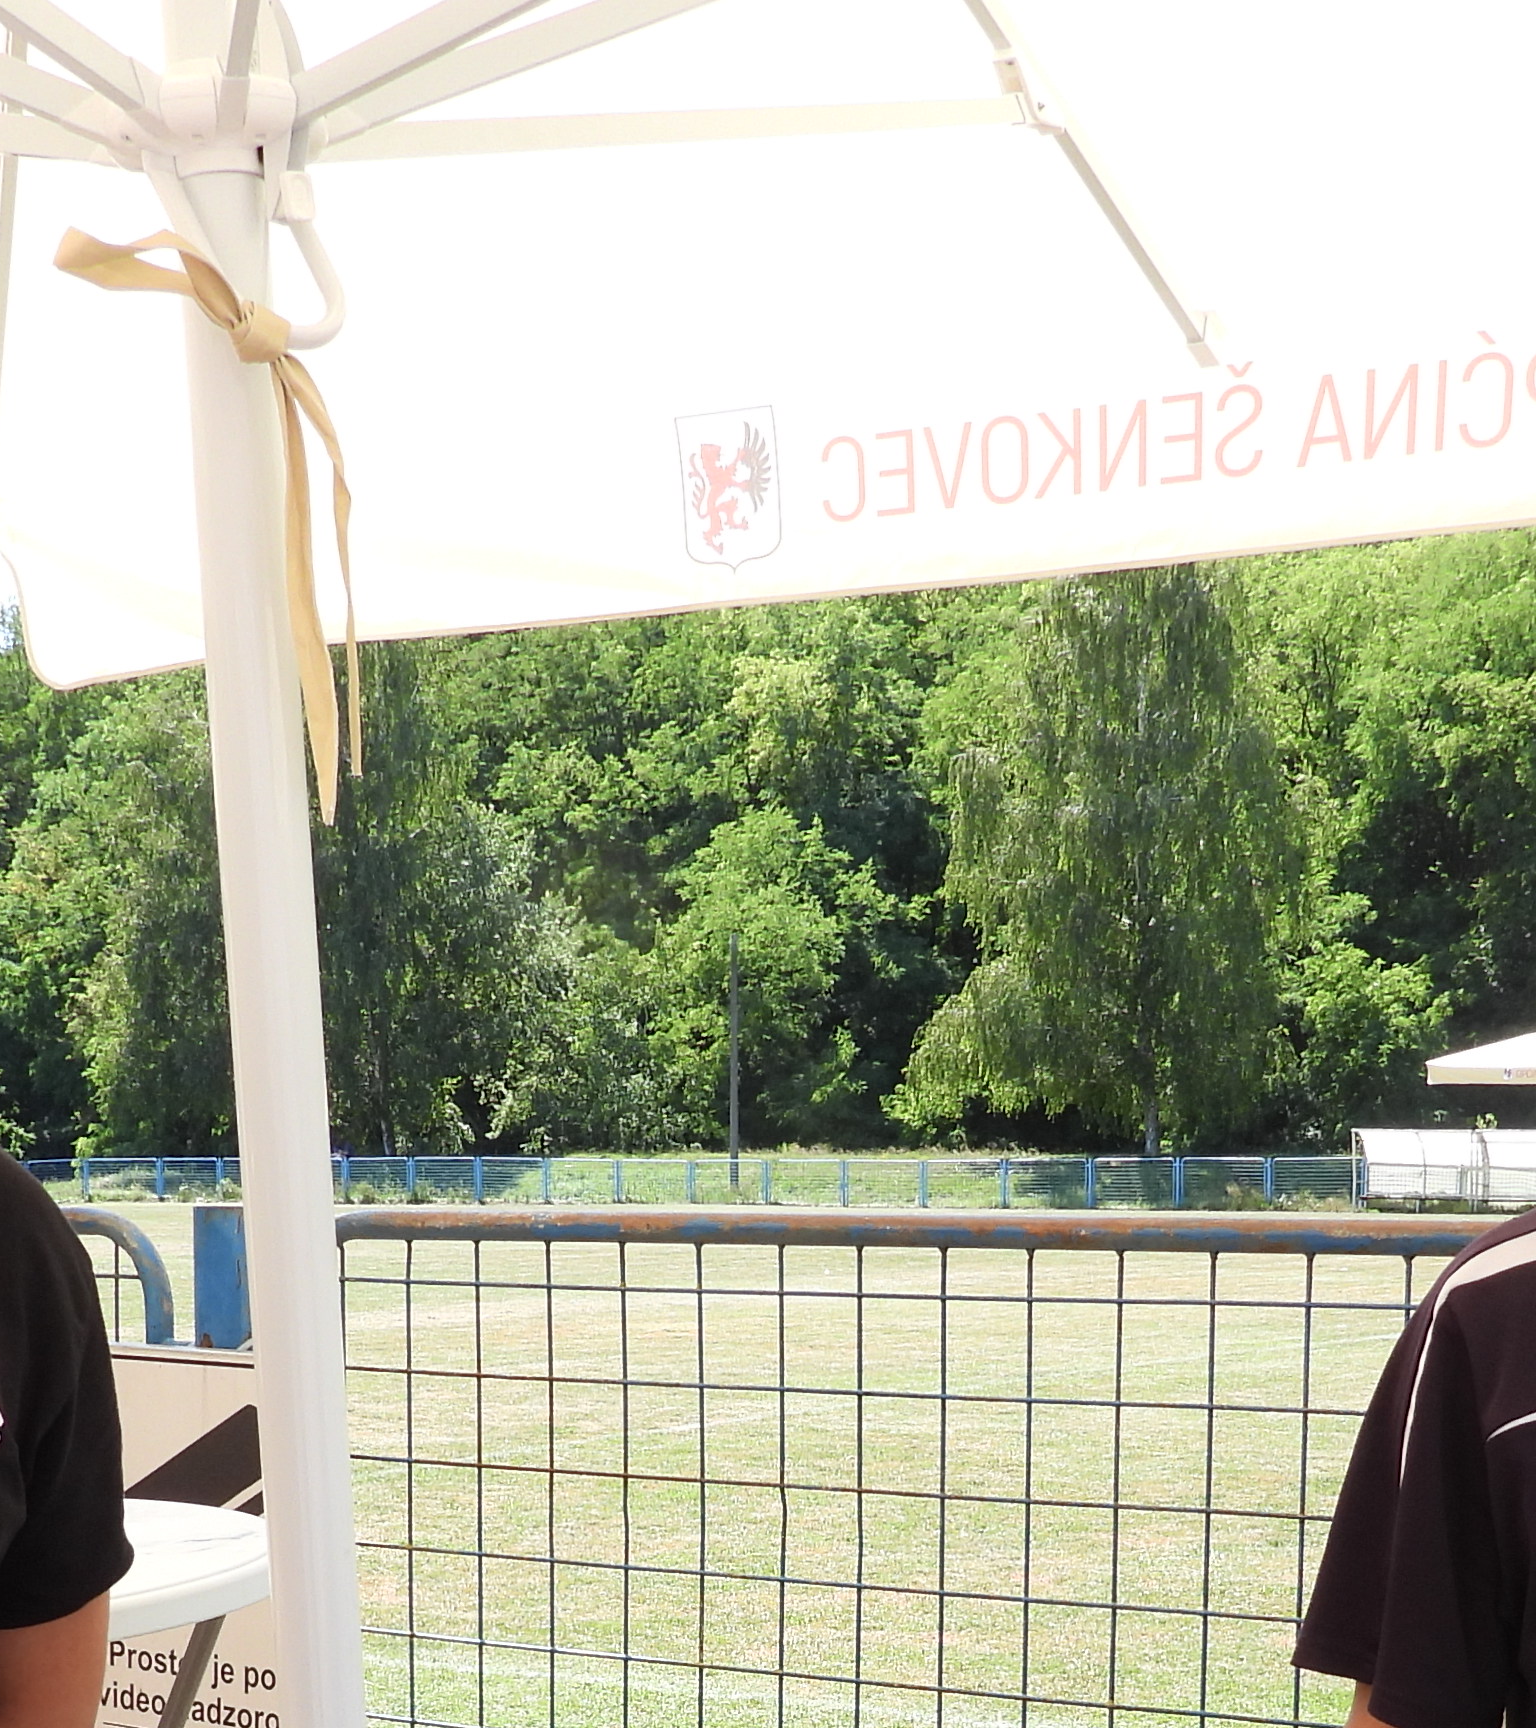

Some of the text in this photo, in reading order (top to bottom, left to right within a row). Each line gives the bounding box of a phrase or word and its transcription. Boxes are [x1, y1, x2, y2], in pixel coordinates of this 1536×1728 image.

[110, 1640, 277, 1694] Prost je po
